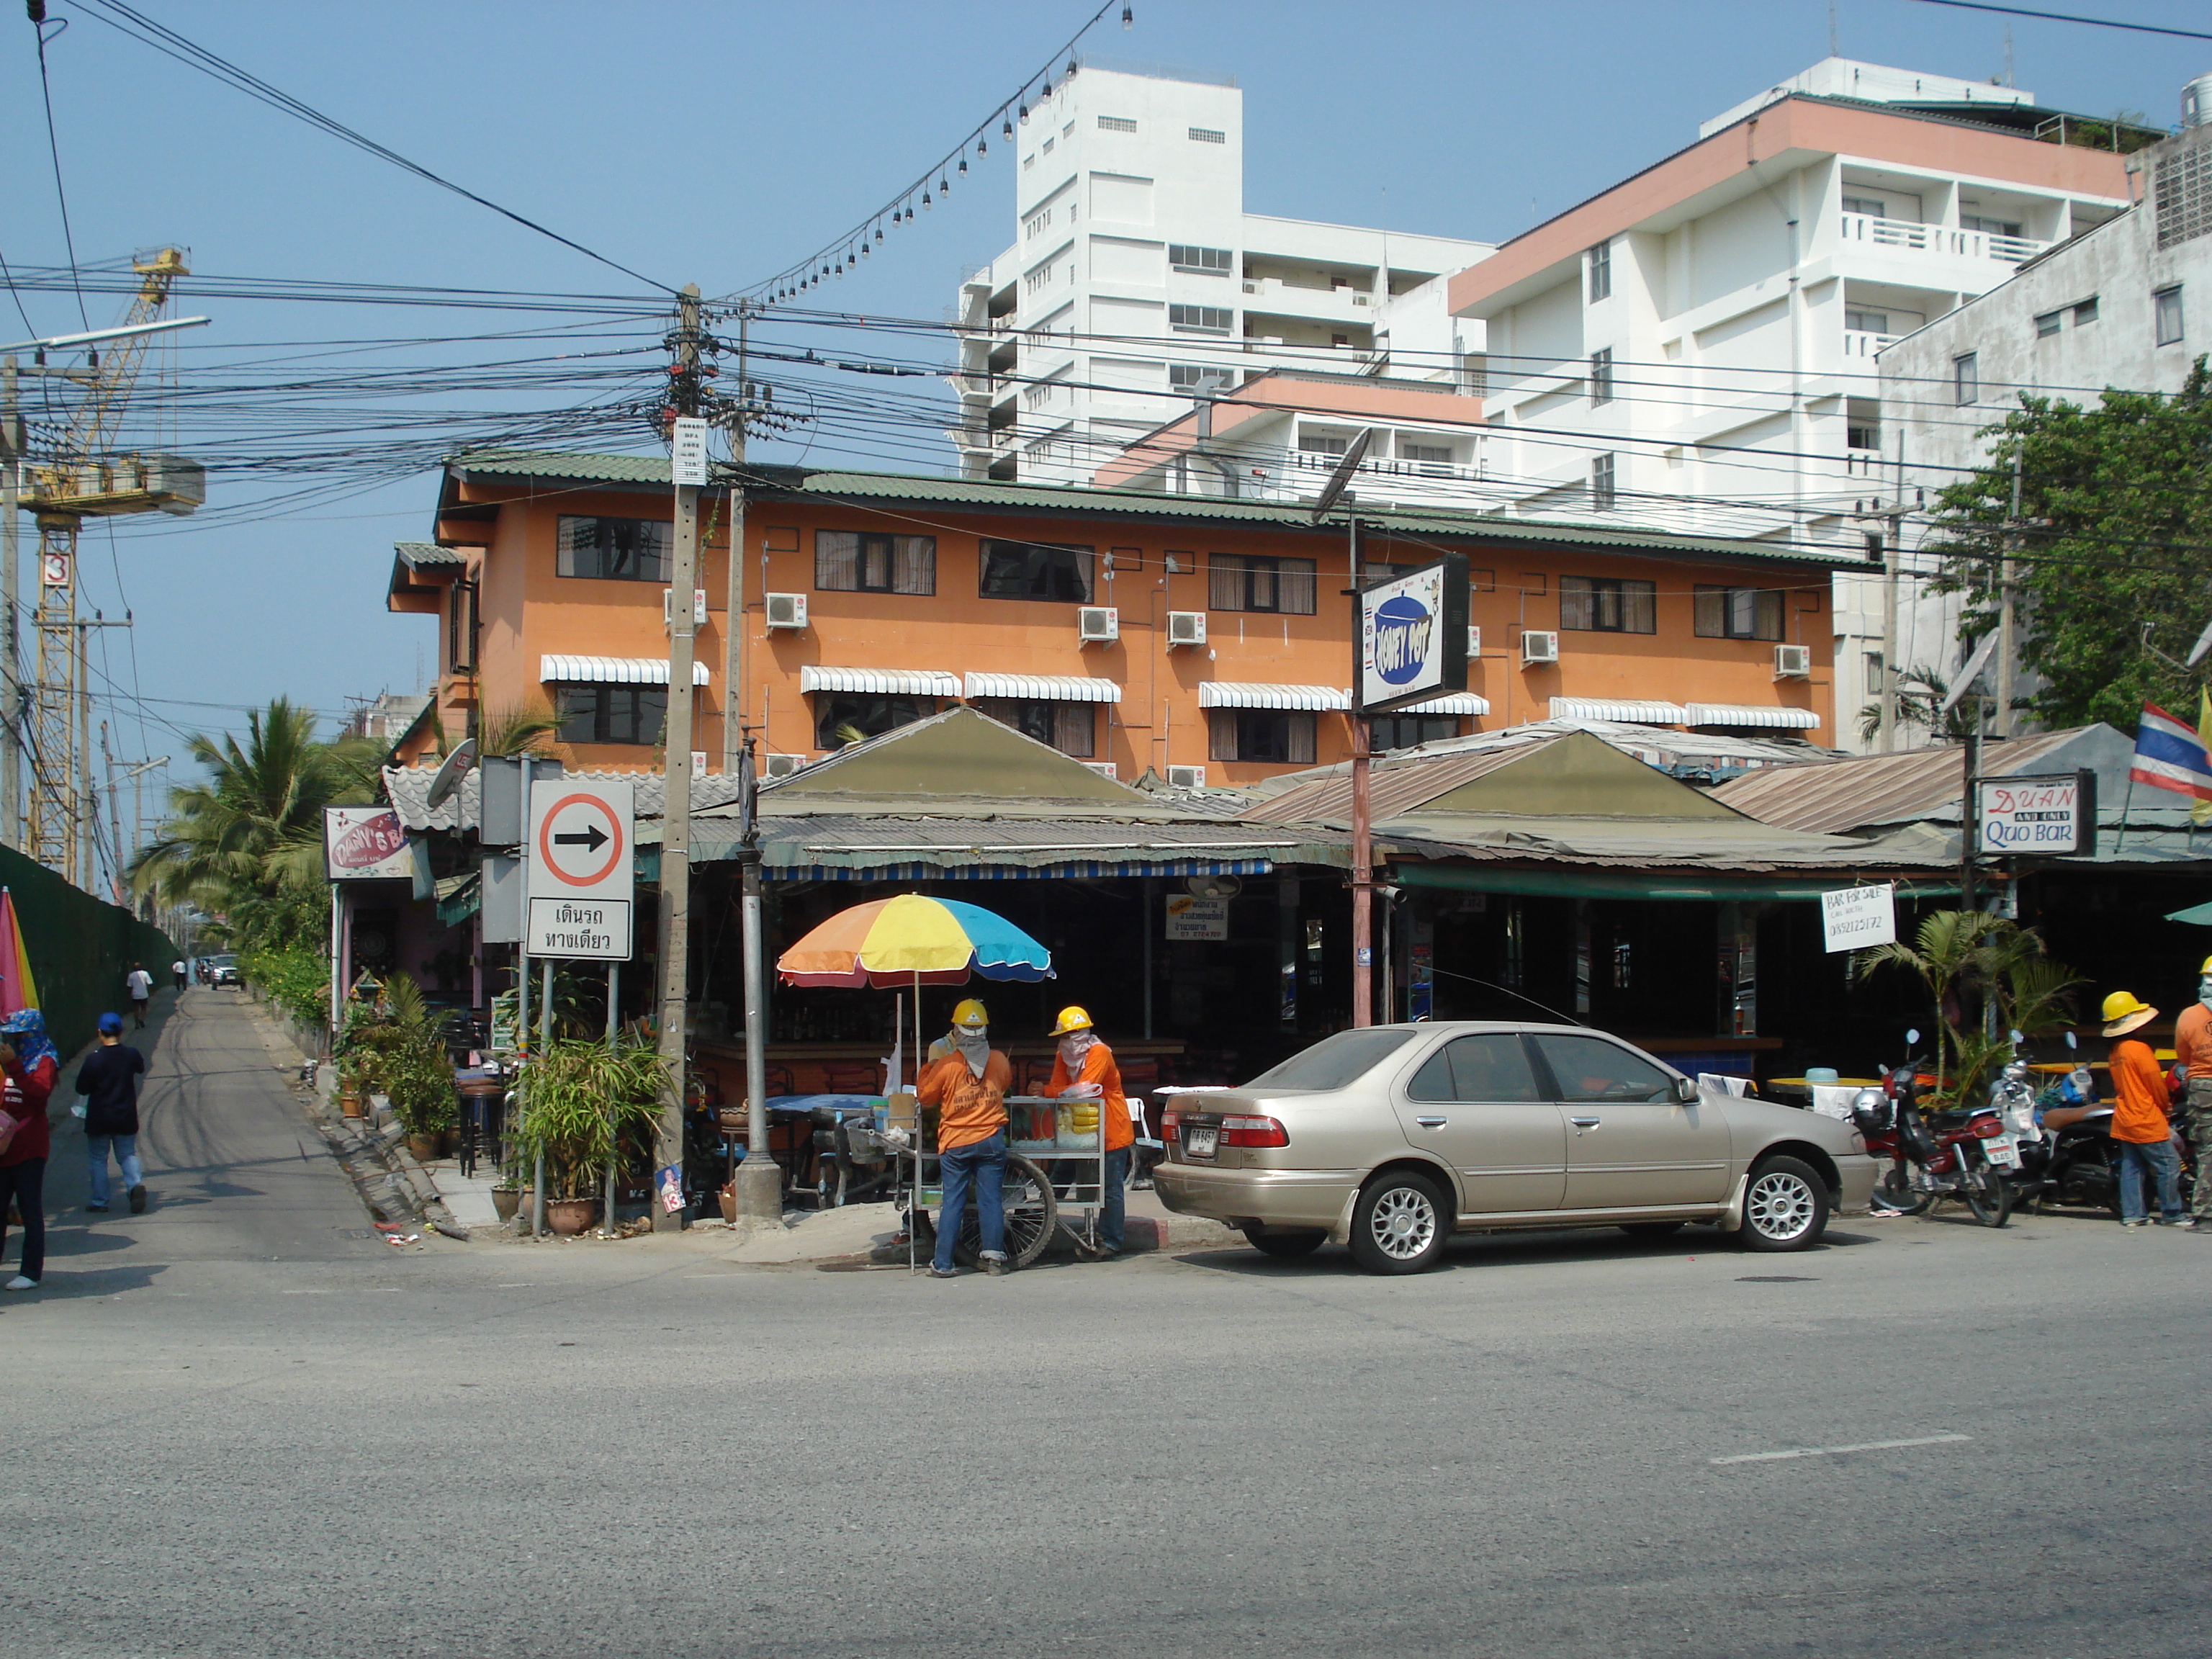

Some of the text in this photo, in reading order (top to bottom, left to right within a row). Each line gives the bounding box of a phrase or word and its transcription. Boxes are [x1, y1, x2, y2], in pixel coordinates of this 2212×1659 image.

[48, 556, 66, 581] 3
[1376, 619, 1429, 675] HONEY POT
[1388, 685, 1416, 698] BEER BAR
[1988, 788, 2076, 814] DUAN
[2016, 811, 2069, 821] AND ONLY
[1827, 894, 1845, 909] BAR
[556, 904, 603, 924] เดินรถ
[545, 929, 611, 949] ทางเดียว
[662, 1192, 680, 1213] 13
